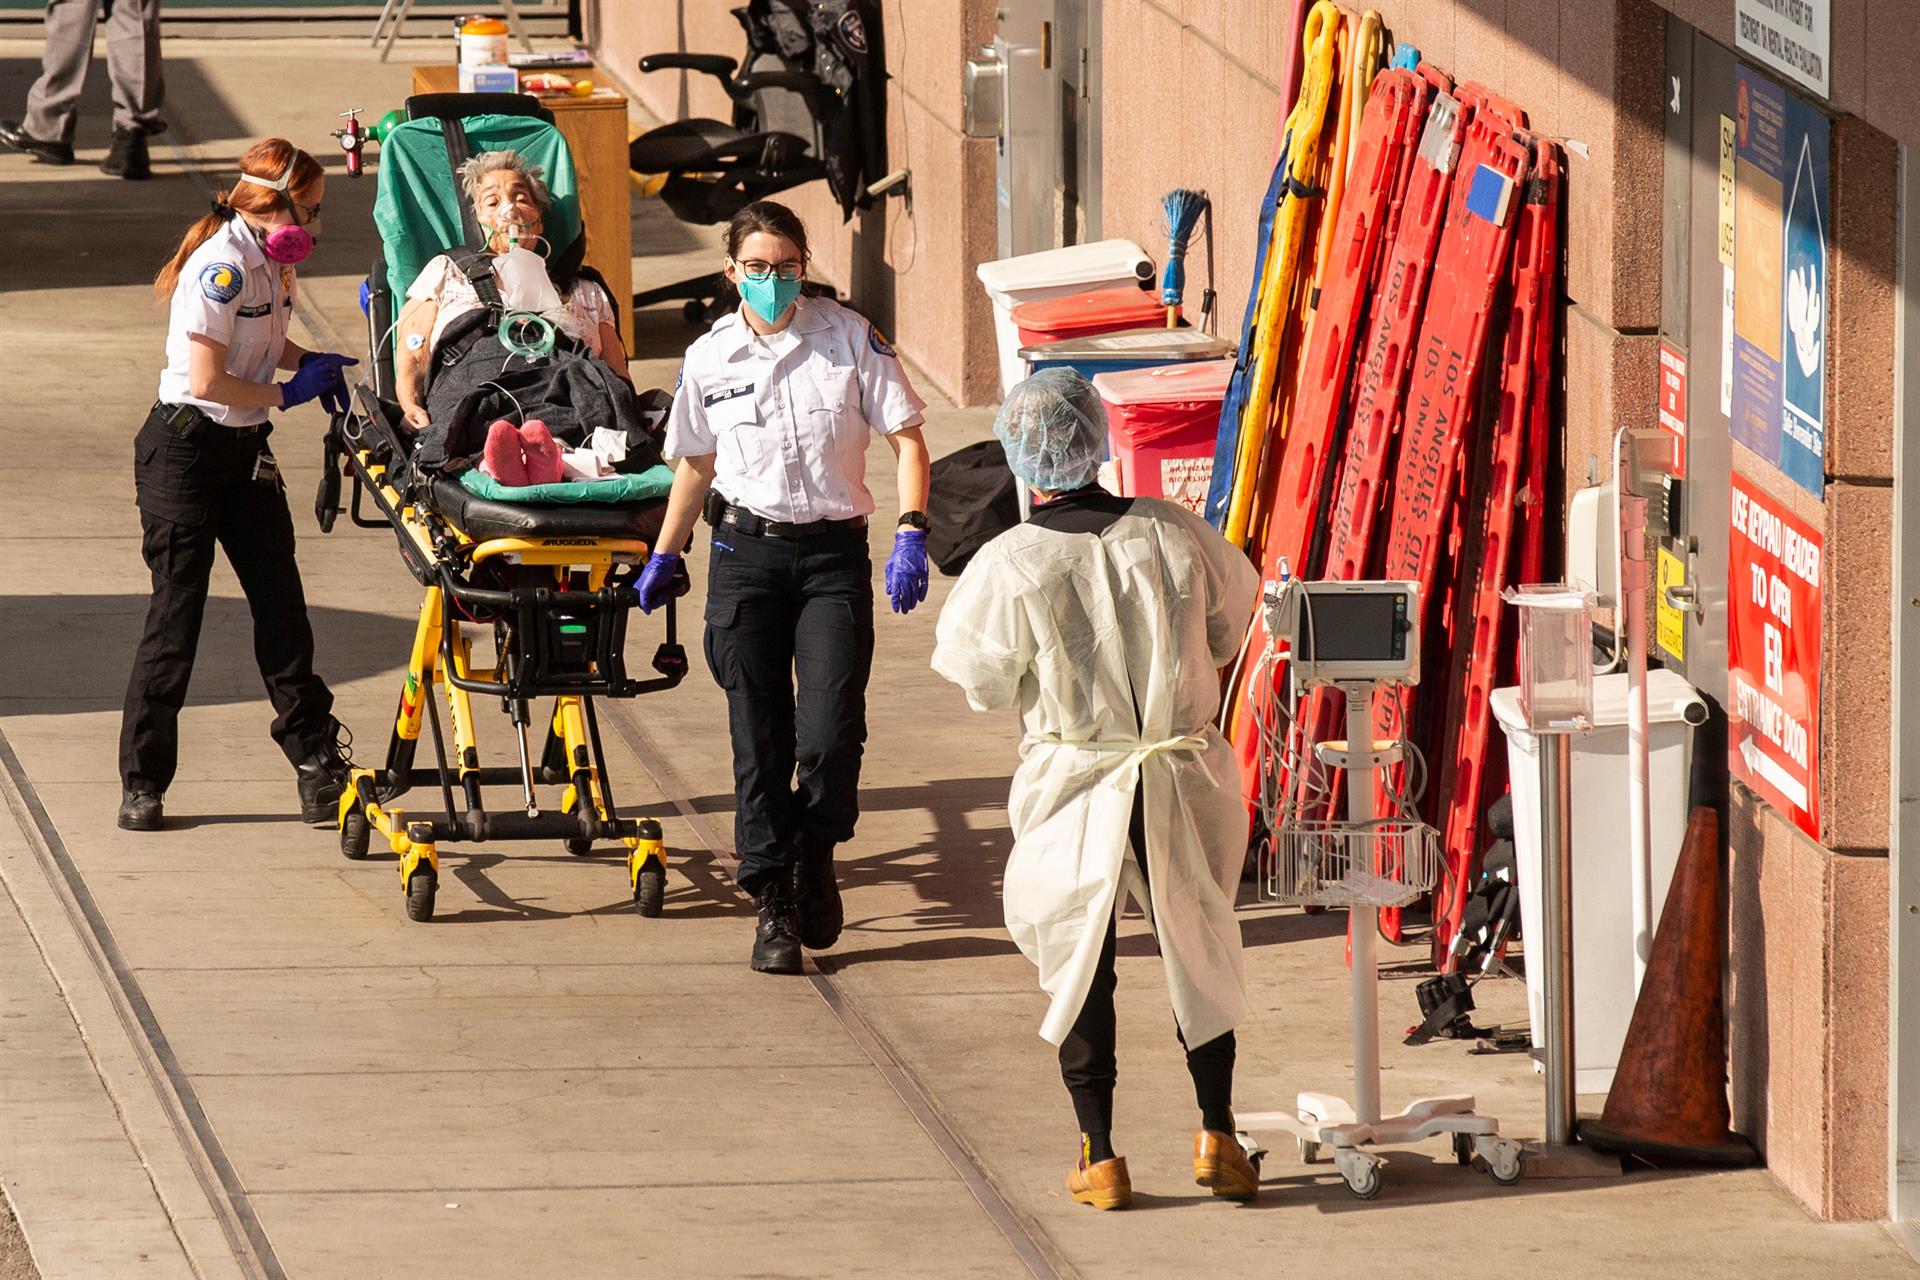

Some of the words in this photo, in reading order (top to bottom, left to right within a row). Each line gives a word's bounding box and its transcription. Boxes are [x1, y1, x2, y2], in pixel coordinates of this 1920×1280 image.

[1389, 260, 1406, 304] LOS
[1361, 315, 1392, 426] ANGELES
[1424, 335, 1443, 379] LOS
[1443, 351, 1463, 398] LOS
[1348, 437, 1365, 496] CITY
[1416, 408, 1448, 522] ANGELES
[1336, 505, 1351, 561] FIRE
[1732, 486, 1749, 535] USE
[1406, 534, 1423, 577] CIT
[1750, 562, 1767, 608] TO
[1770, 574, 1792, 629] OPEN
[1764, 622, 1783, 697] ER
[1379, 685, 1395, 737] EPT
[1736, 676, 1783, 748] ENTRANCE
[1783, 712, 1808, 770] DOOR
